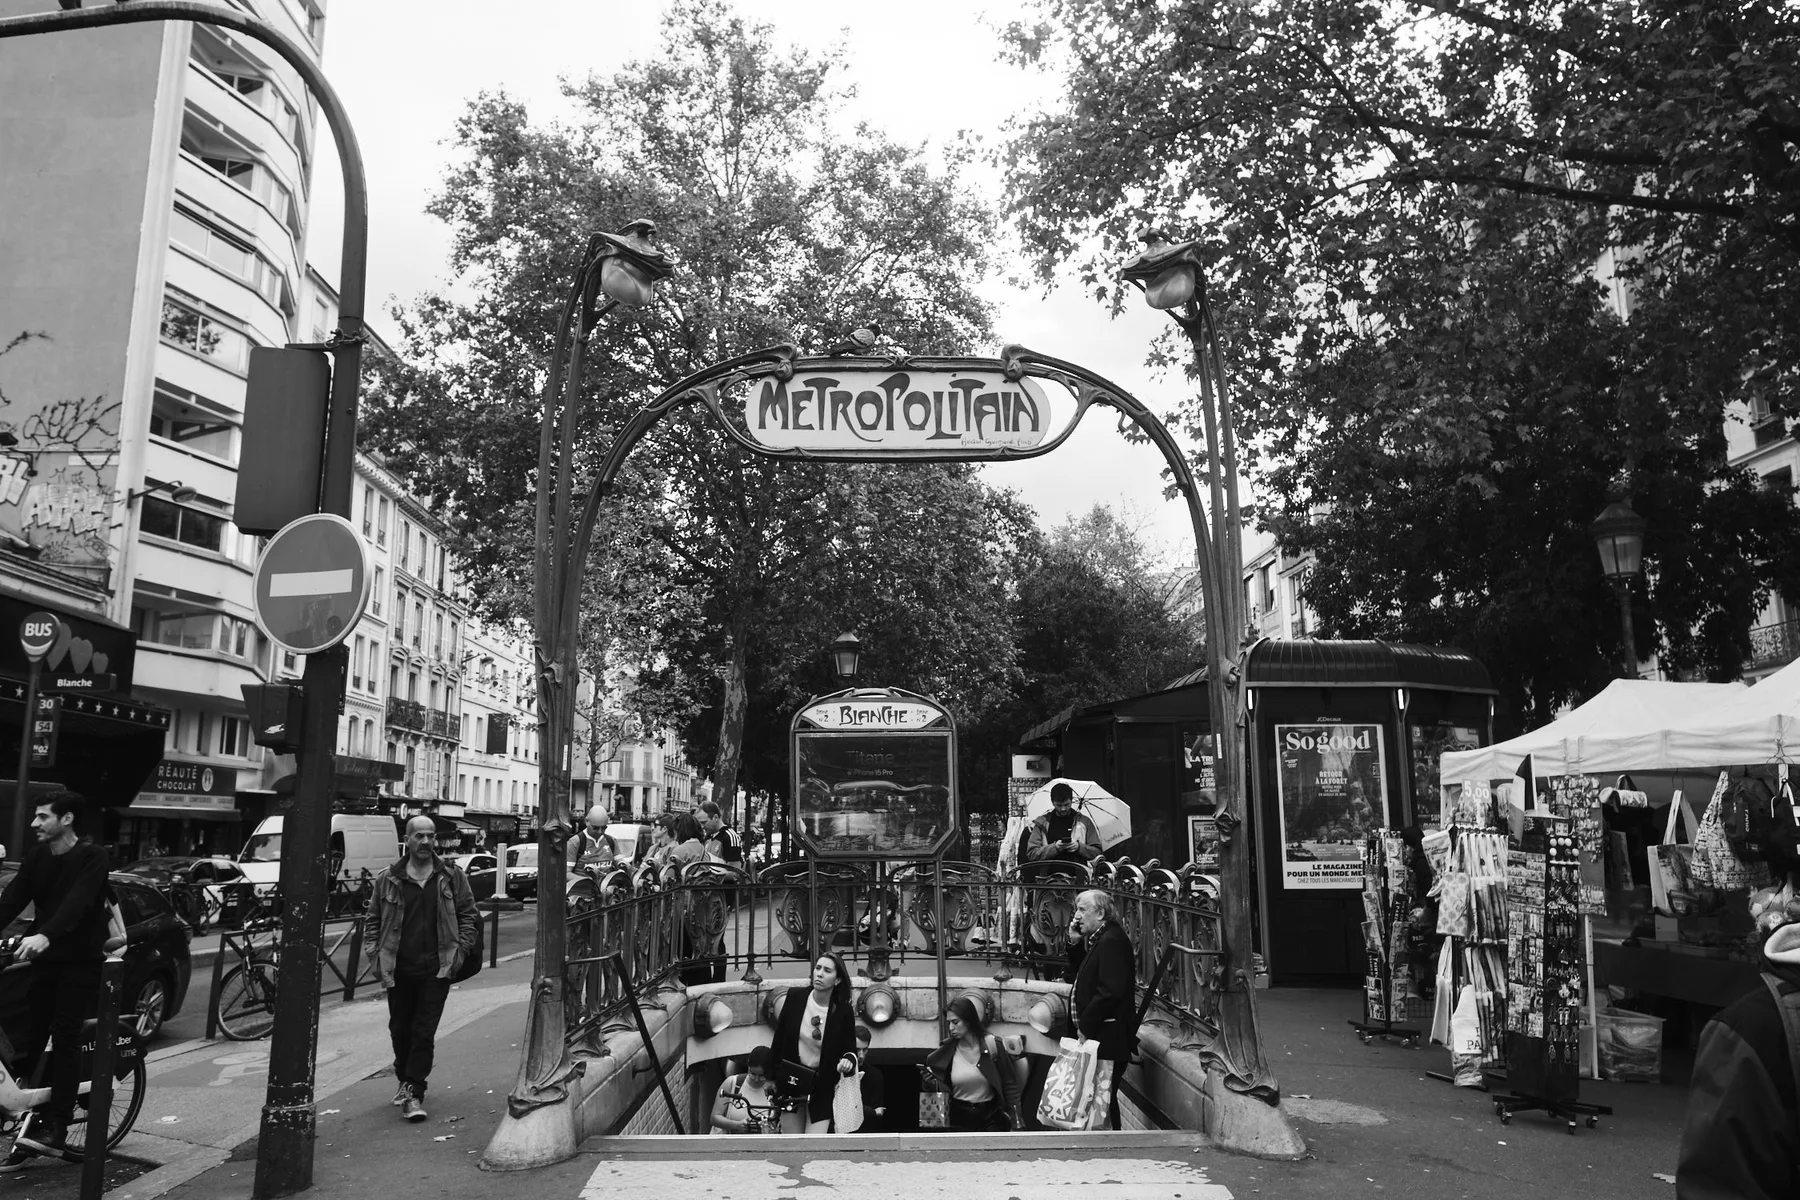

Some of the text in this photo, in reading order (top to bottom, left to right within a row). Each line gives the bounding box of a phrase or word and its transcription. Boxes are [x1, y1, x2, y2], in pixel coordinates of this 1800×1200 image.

[758, 372, 1040, 442] METROPOLITAIN
[24, 623, 53, 637] BUS
[56, 678, 93, 687] Blanche
[39, 699, 54, 709] 30
[839, 705, 908, 726] BLANCHE
[1286, 730, 1371, 754] So good
[158, 763, 197, 779] RÉAUTÉ
[157, 780, 197, 790] CHOCOLAT
